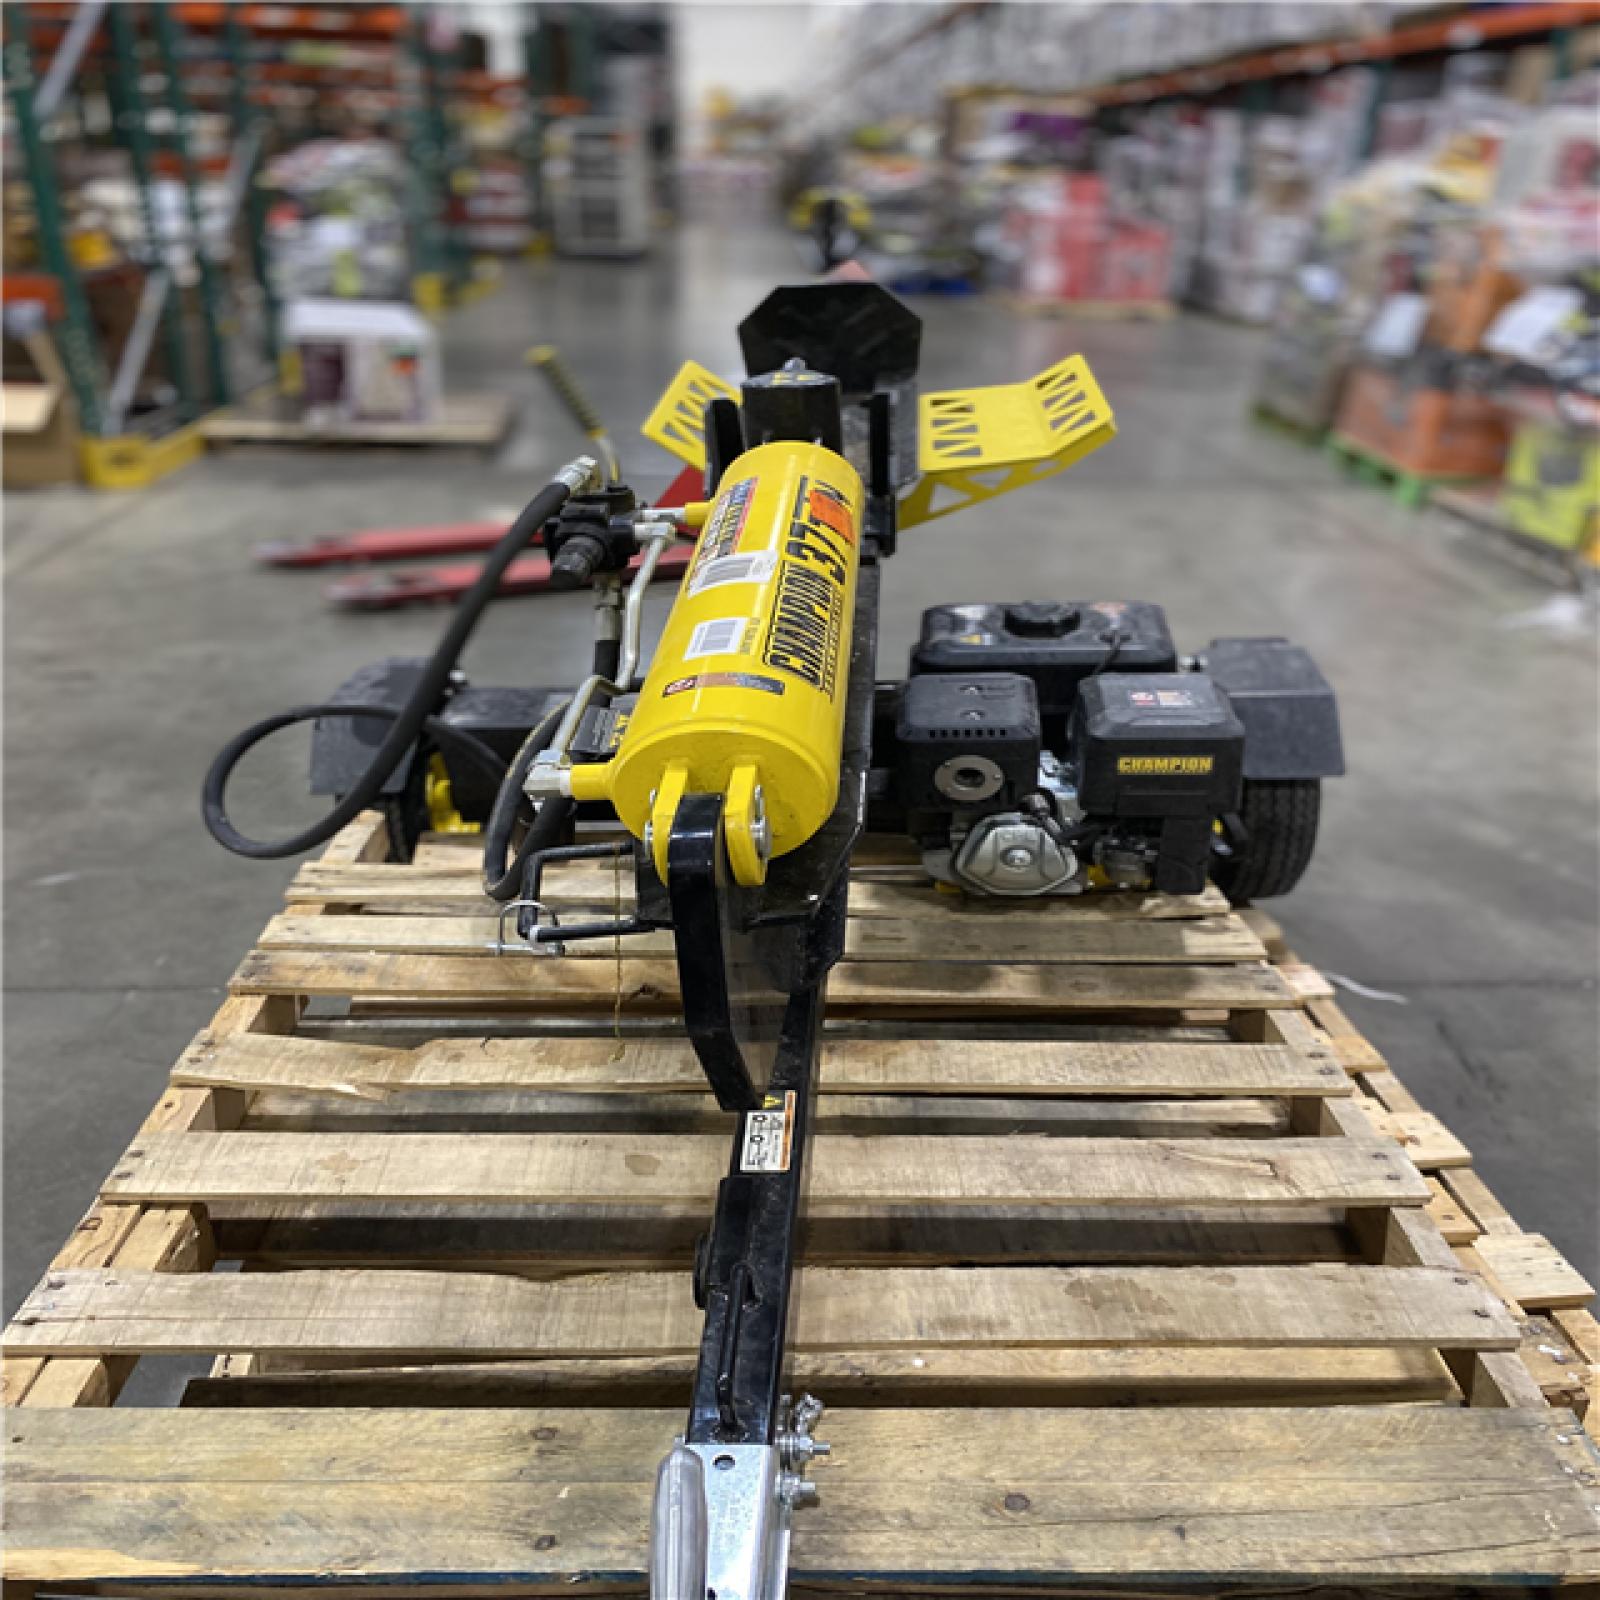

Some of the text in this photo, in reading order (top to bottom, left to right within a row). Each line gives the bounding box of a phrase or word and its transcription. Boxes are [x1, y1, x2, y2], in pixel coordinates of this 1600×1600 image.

[785, 522, 846, 586] 37
[764, 559, 833, 688] CHAMPION
[1117, 755, 1214, 775] CHAMPION
